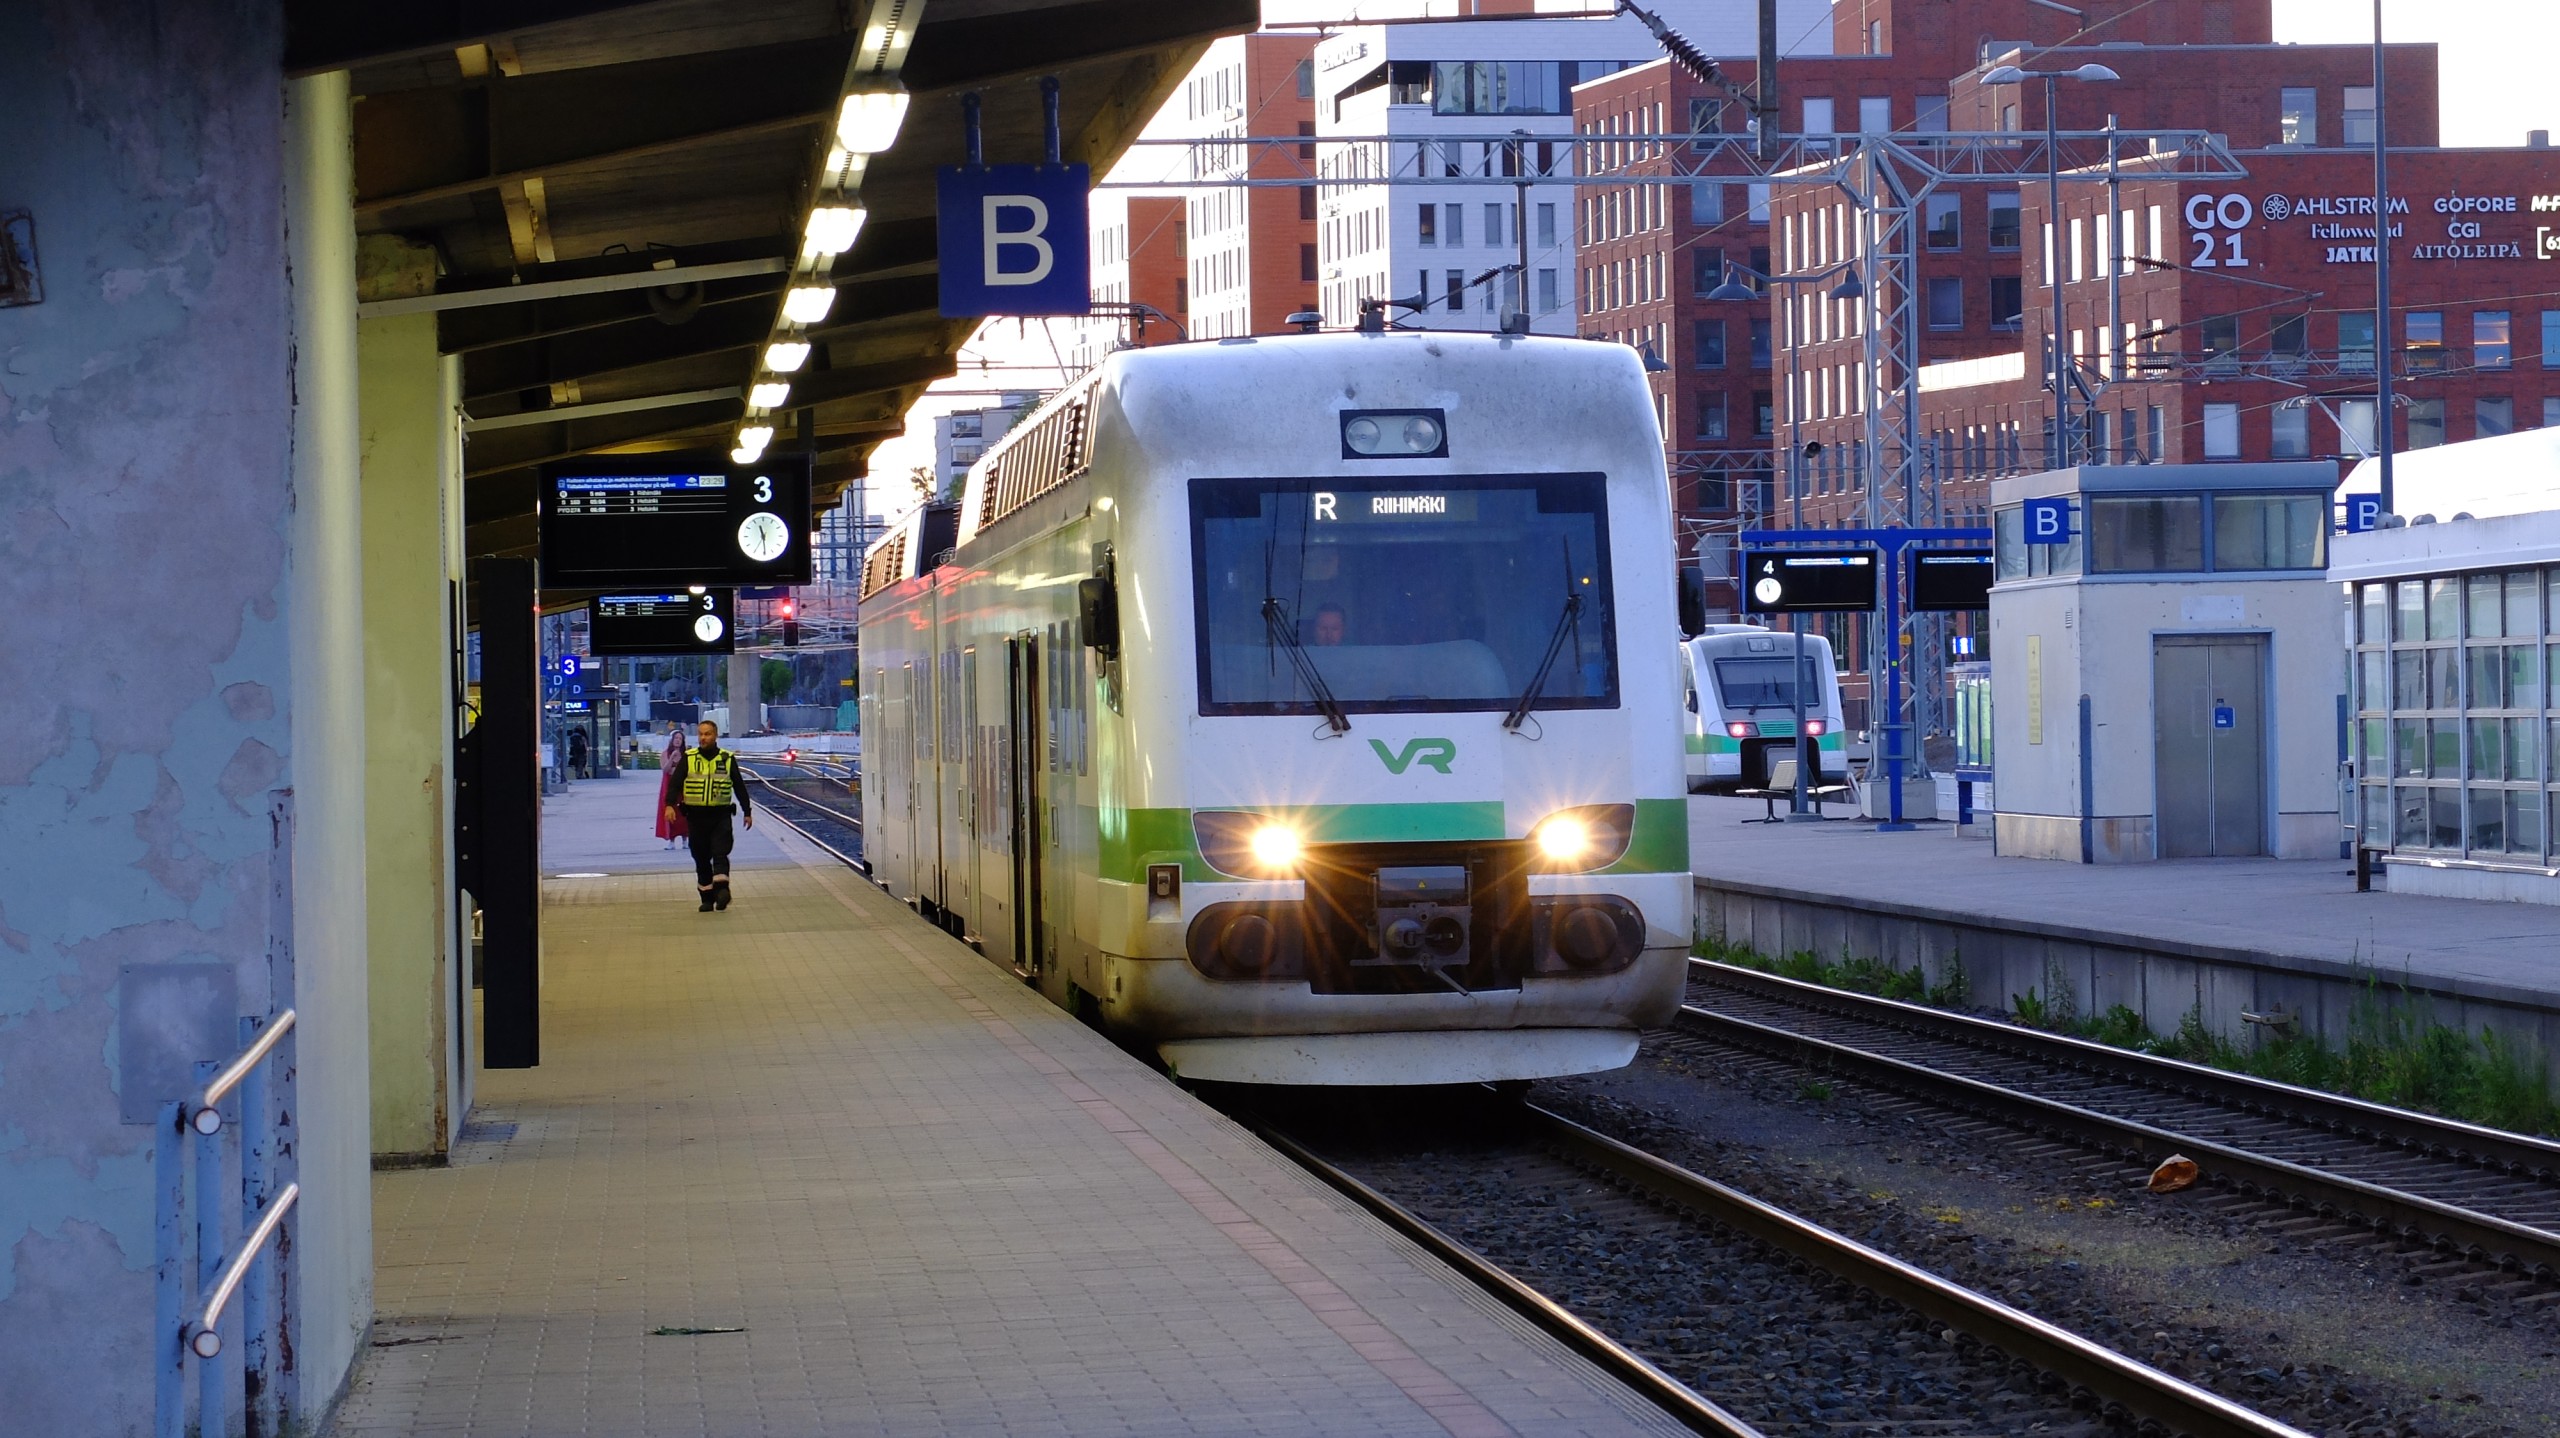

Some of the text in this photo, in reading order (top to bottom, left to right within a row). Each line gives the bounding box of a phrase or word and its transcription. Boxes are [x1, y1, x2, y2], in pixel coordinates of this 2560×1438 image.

[2185, 193, 2253, 229] GO
[2434, 197, 2516, 213] GOFORE
[2448, 222, 2480, 238] CGI
[983, 195, 1053, 285] B
[2191, 232, 2249, 267] 21
[701, 477, 723, 486] 23:29
[753, 476, 772, 503] 3
[1315, 493, 1337, 520] R
[1373, 496, 1445, 514] RIIHIMÄKI
[2037, 507, 2058, 535] B
[2359, 501, 2379, 529] B
[1763, 560, 1774, 574] 4
[703, 595, 714, 610] 3
[564, 659, 575, 675] 3
[553, 675, 563, 685] D
[573, 685, 581, 694] D
[1366, 738, 1456, 775] VR
